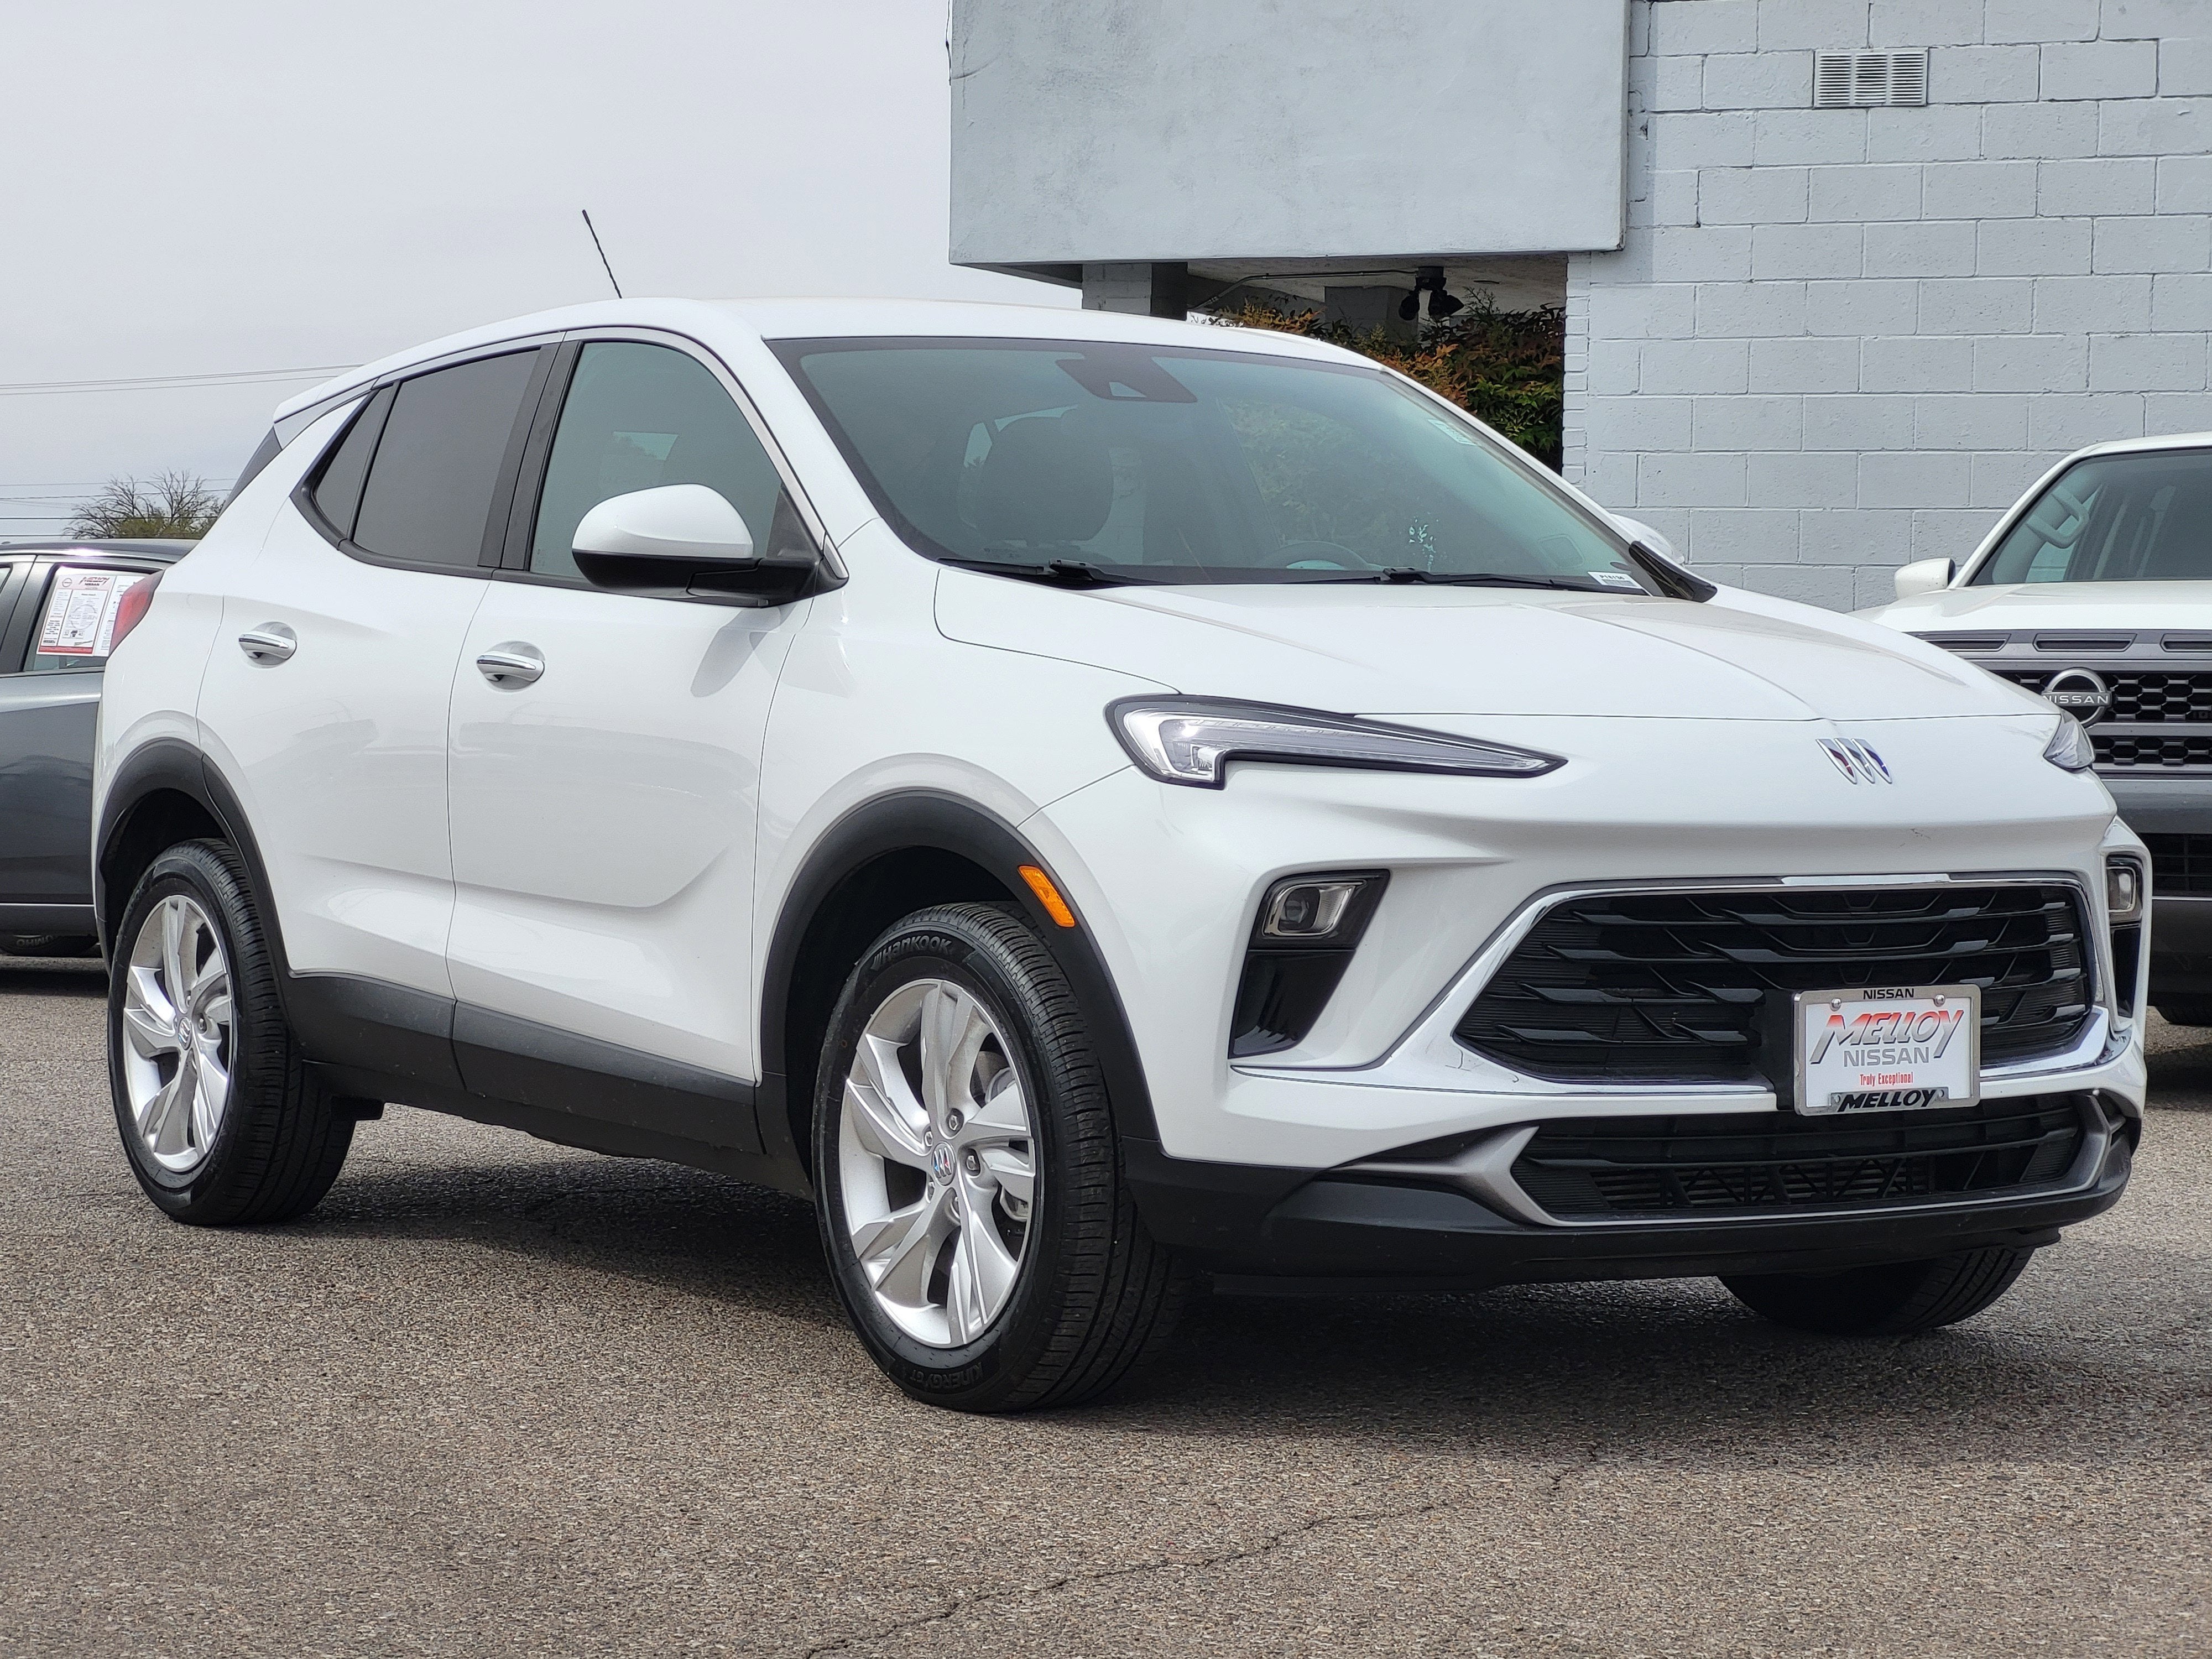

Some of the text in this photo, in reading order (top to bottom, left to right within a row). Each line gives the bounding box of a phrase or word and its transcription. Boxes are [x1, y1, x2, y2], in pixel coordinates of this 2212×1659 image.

[1863, 988, 1914, 1000] NISSAN
[1809, 1009, 1964, 1065] MELLOY
[1844, 1046, 1929, 1067] NISSAN
[1860, 1071, 1913, 1087] Truly Exceptional
[1837, 1089, 1936, 1113] MELLOY
